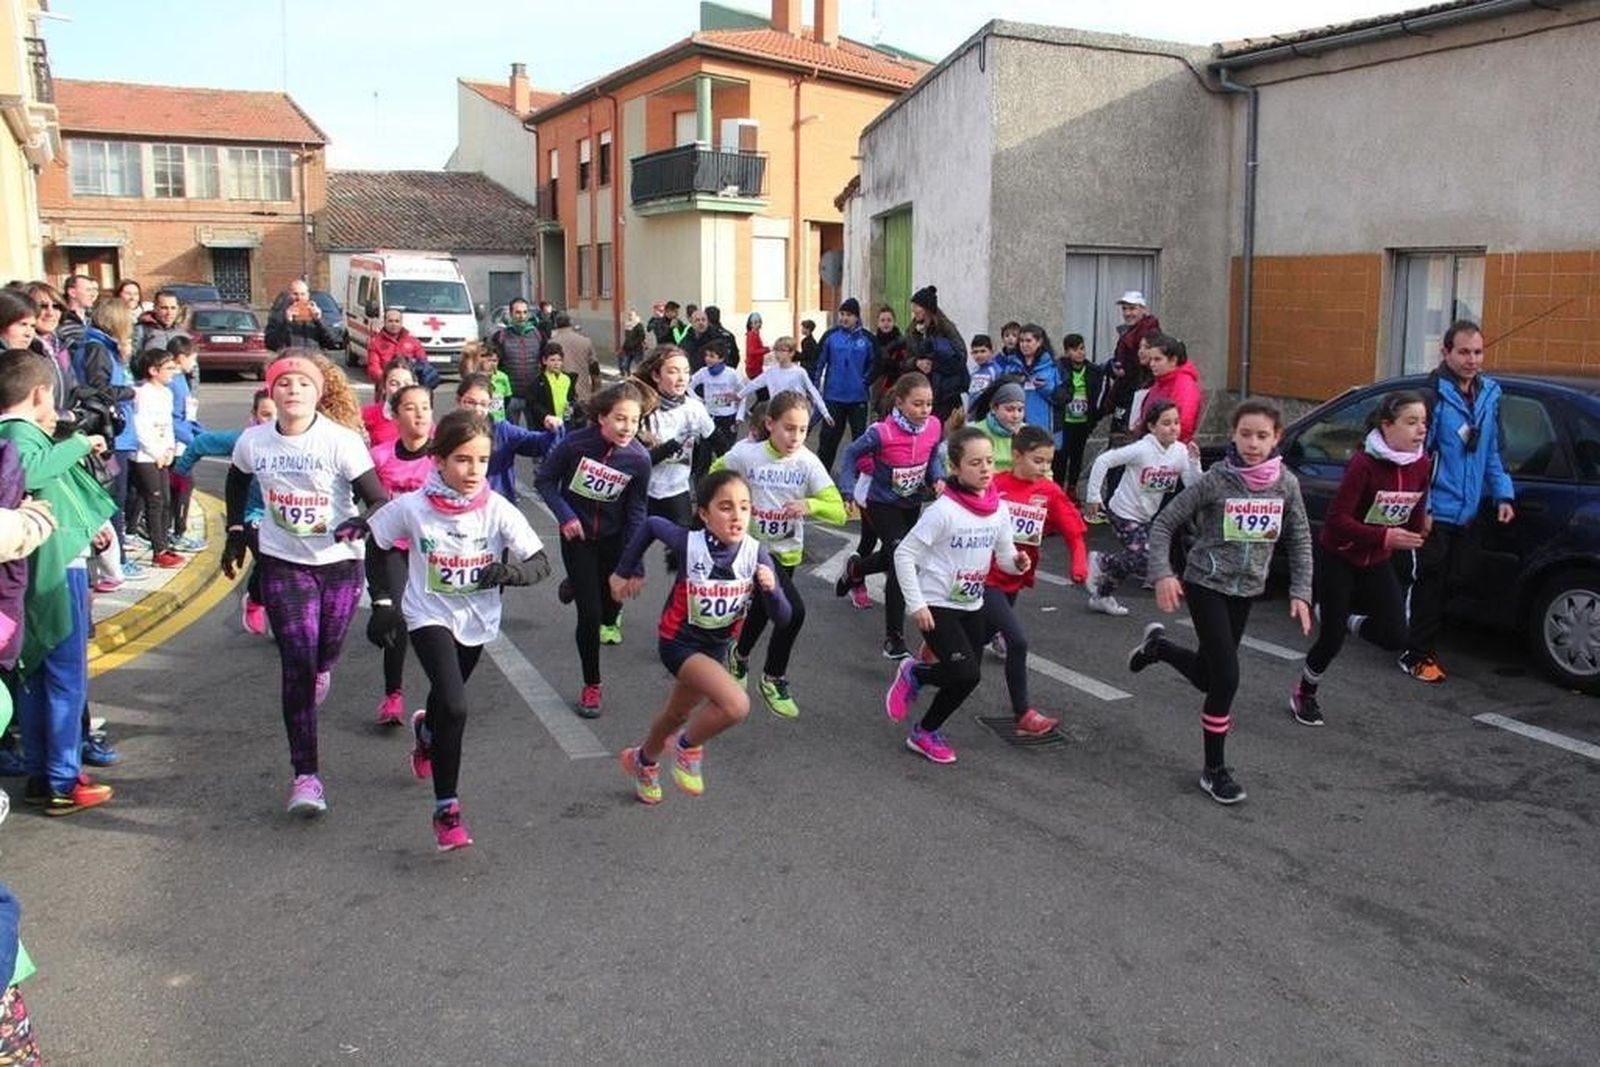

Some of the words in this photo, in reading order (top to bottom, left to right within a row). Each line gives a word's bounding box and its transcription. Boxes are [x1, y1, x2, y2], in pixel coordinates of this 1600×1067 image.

[256, 458, 266, 471] LA
[582, 474, 615, 495] 201
[268, 489, 328, 506] bedunia
[279, 506, 316, 525] 195
[1009, 507, 1044, 521] edunia
[1226, 502, 1281, 514] bedunia
[759, 521, 787, 535] 181
[1235, 515, 1270, 531] 199
[951, 537, 962, 548] LA
[429, 552, 494, 567] bedunia
[440, 567, 480, 585] 210
